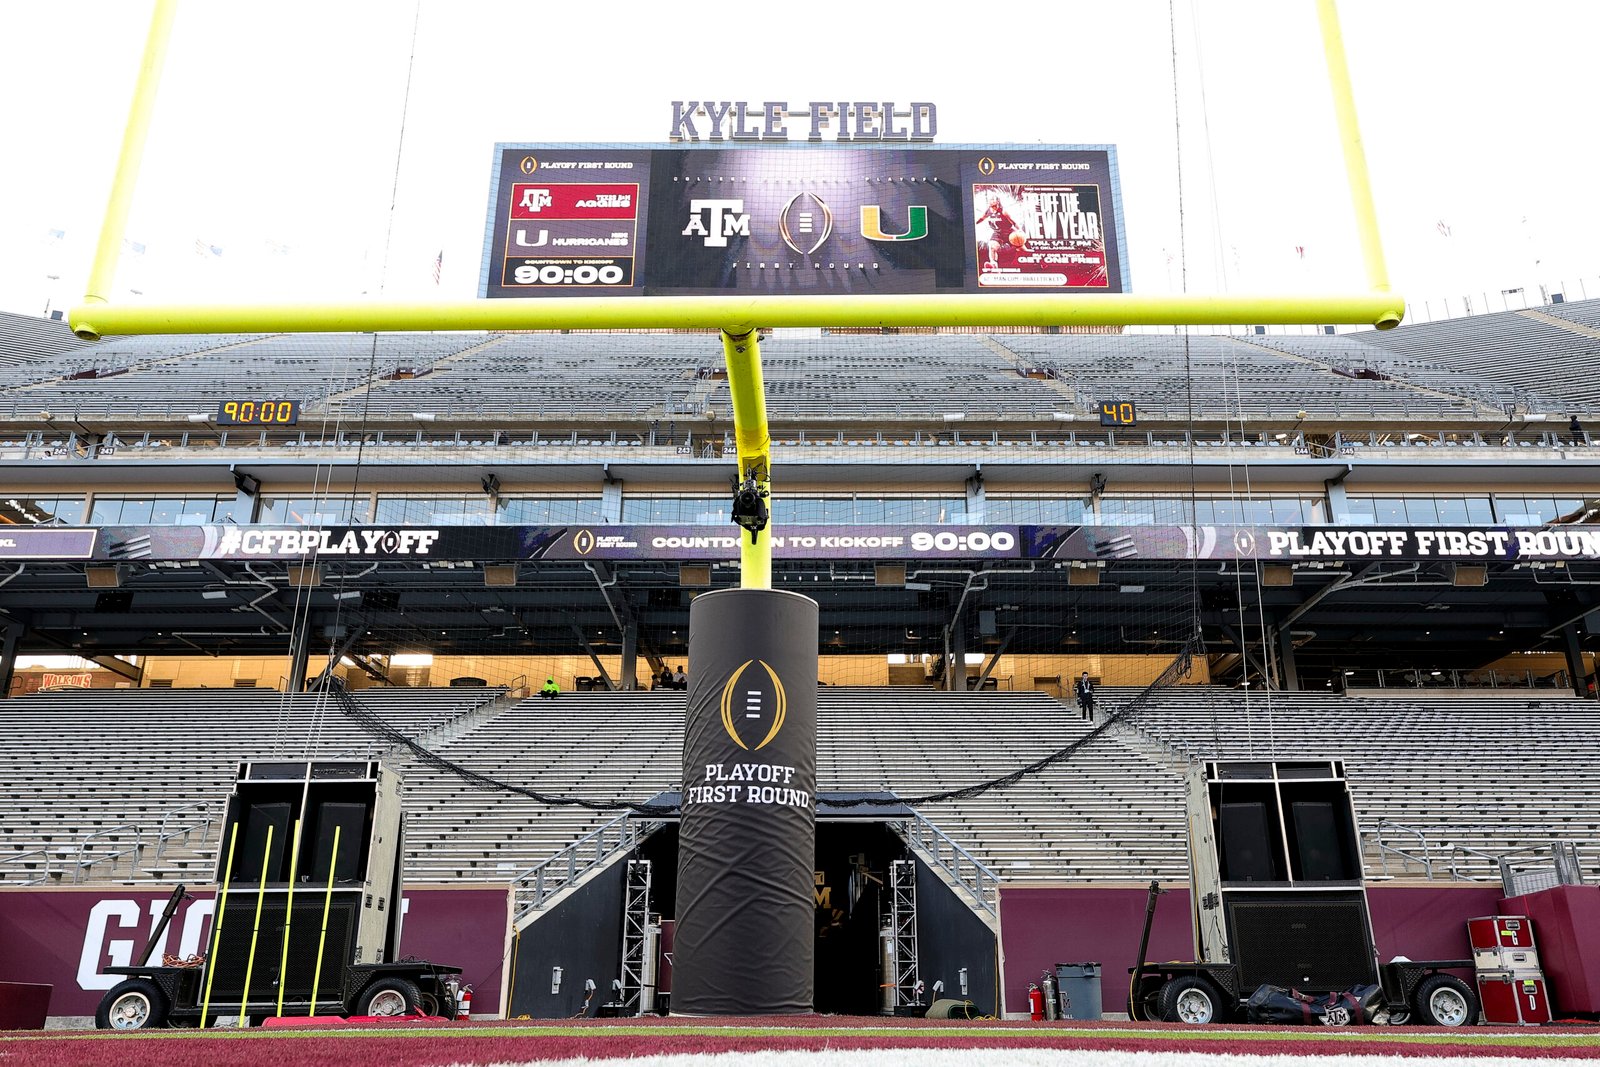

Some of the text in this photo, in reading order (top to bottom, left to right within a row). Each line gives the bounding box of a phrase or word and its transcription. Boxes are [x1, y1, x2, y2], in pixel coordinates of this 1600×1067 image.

[671, 101, 938, 138] KYLE FIELD
[1022, 211, 1099, 240] NEW YEAR
[516, 229, 549, 247] U
[552, 238, 629, 246] HURRICANES
[514, 265, 624, 284] 90:00
[224, 401, 292, 423] 90:00
[1103, 402, 1133, 423] 40
[652, 532, 1015, 551] COUNTDN TO KICKOFF 90:00
[1267, 531, 1407, 556] PLAYOFF
[1414, 531, 1510, 556] FIRST
[705, 763, 796, 784] PLAYOFF
[687, 785, 810, 808] FIRST ROUND
[1511, 930, 1519, 946] G
[1528, 994, 1537, 1011] D
